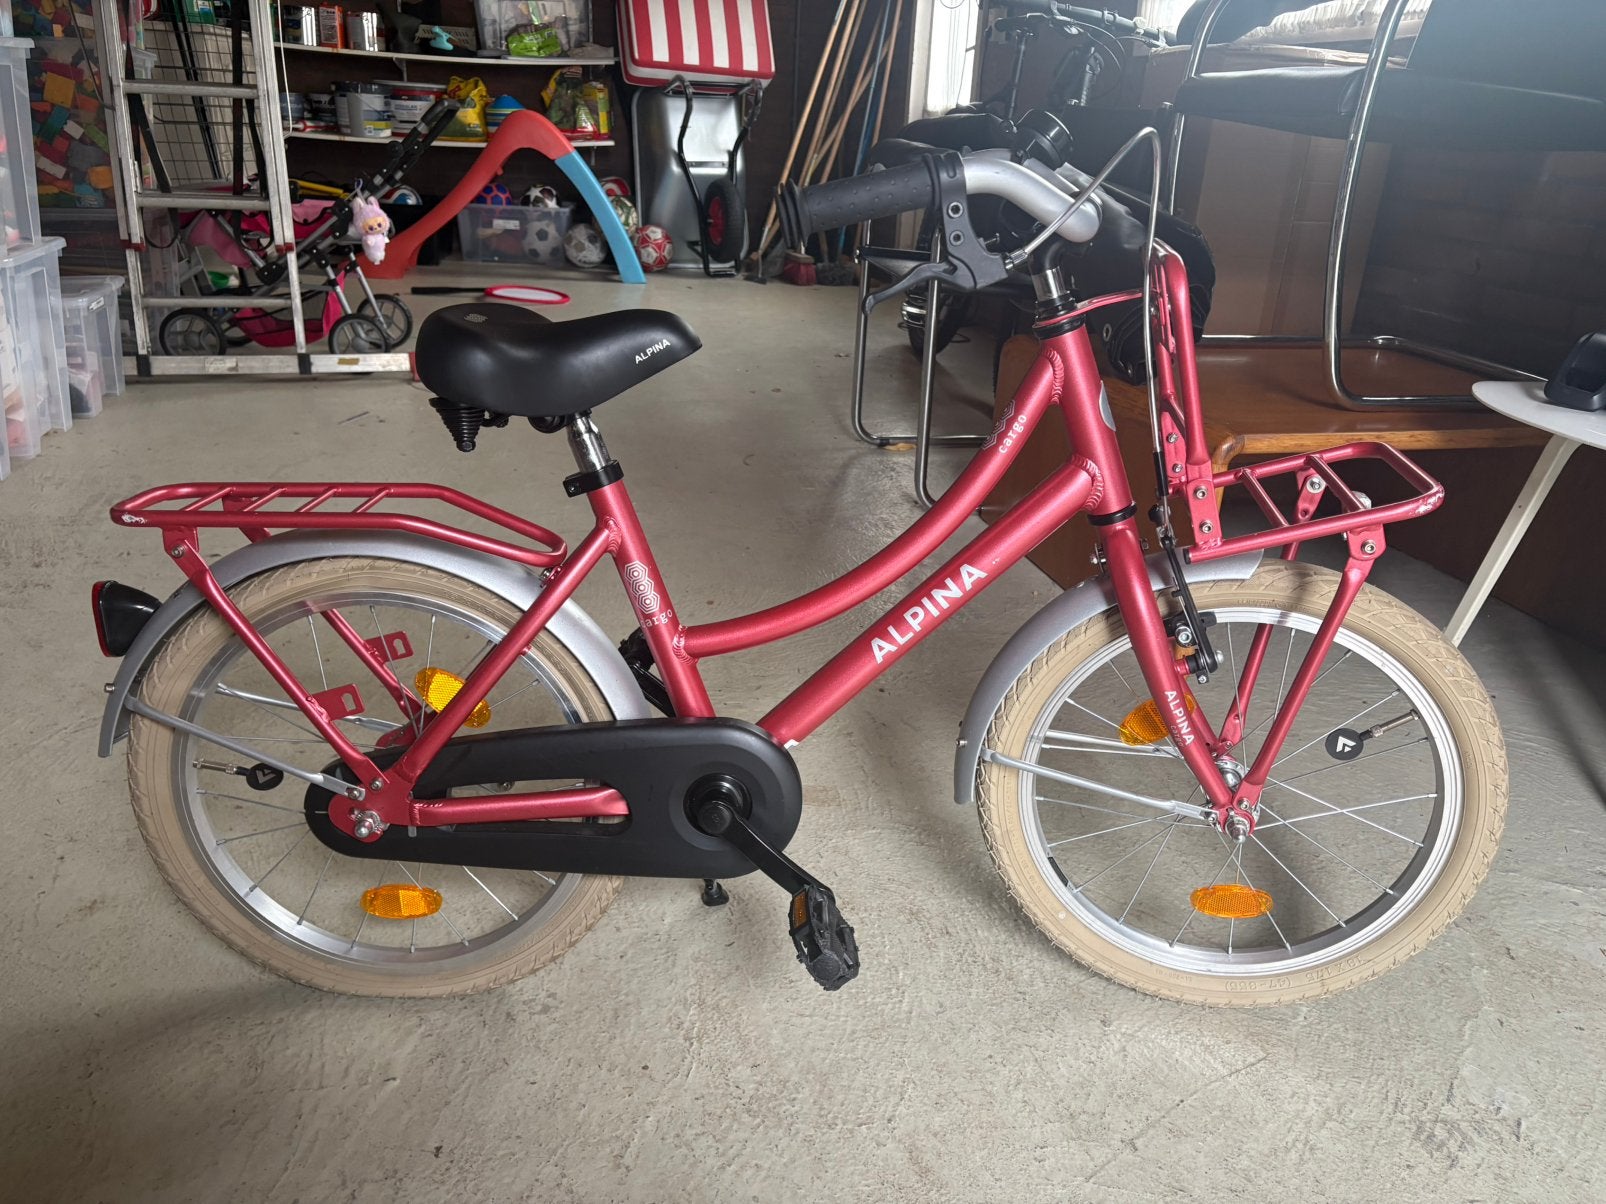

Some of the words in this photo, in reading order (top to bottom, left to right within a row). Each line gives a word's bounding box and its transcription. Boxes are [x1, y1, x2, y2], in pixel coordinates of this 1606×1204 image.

[635, 338, 671, 364] ALPINA
[998, 414, 1027, 454] cargo
[870, 563, 988, 664] ALPINA
[1164, 690, 1195, 745] ALPINA
